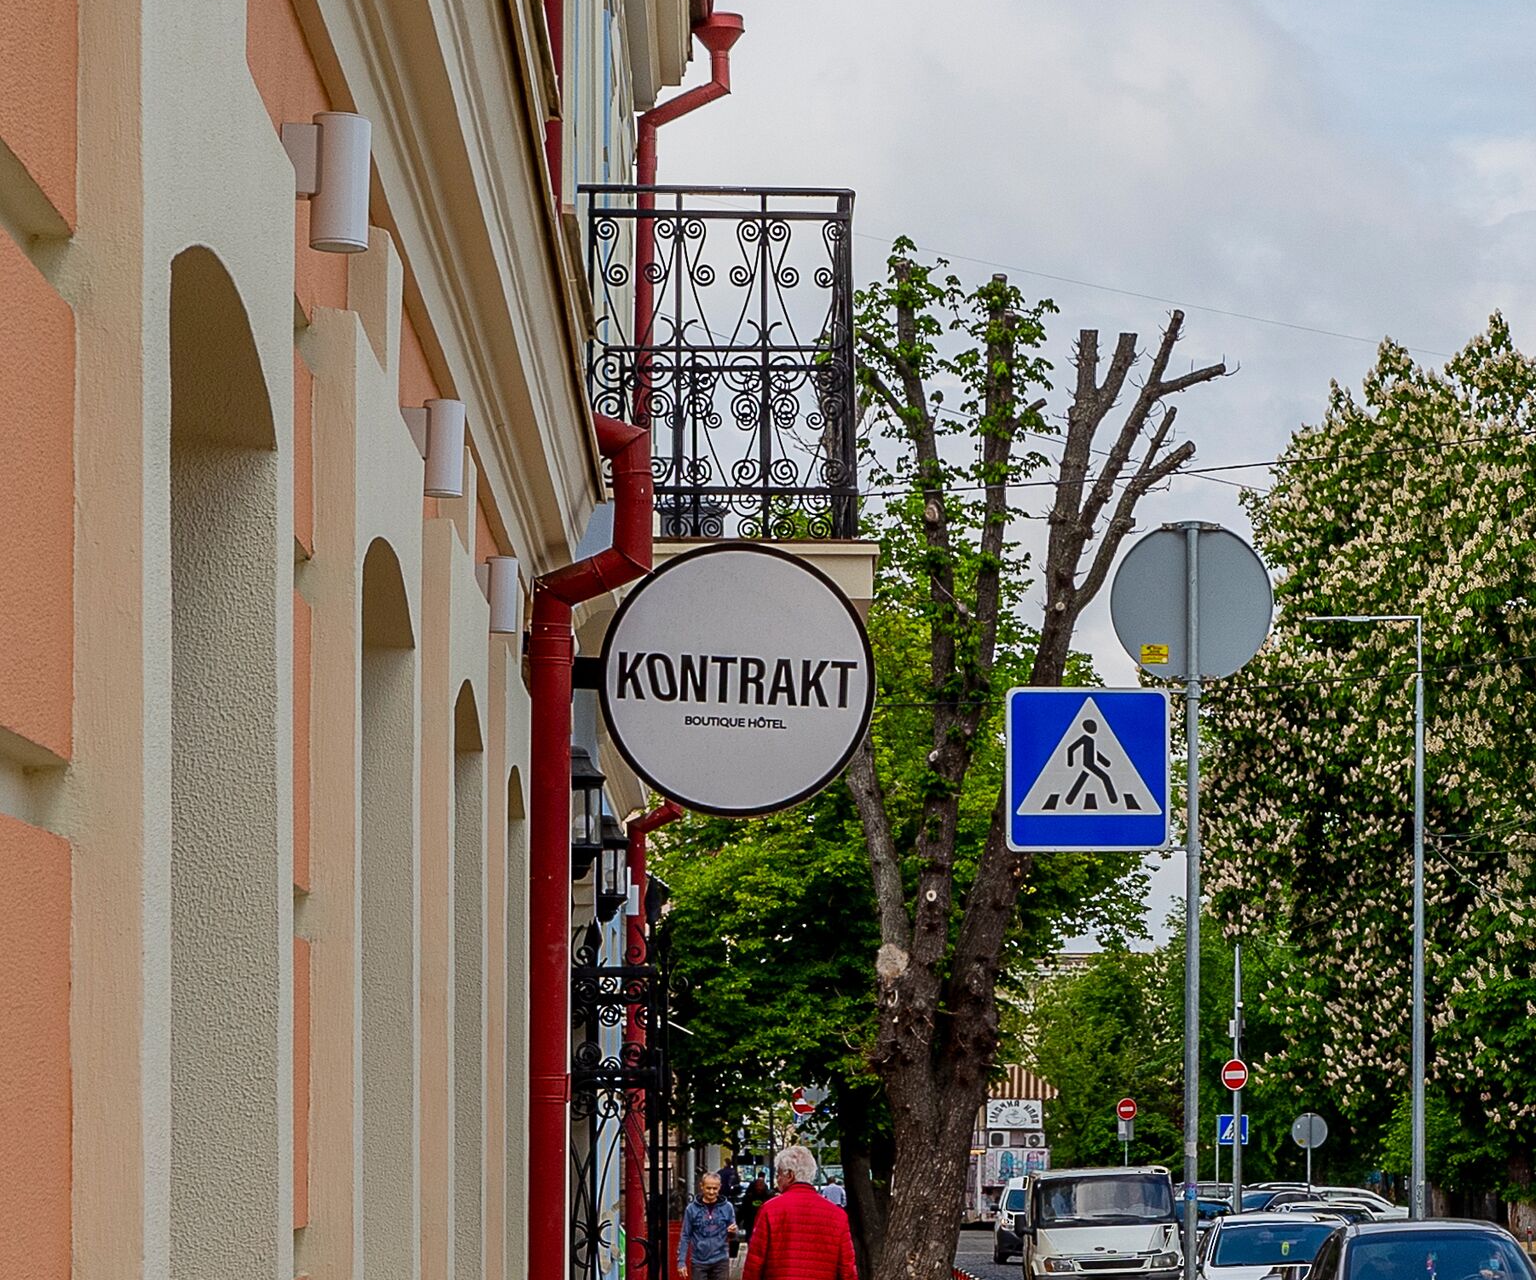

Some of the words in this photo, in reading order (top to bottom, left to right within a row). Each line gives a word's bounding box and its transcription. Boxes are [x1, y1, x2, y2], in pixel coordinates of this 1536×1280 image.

[616, 651, 858, 709] KONTRAKT
[684, 715, 746, 728] BOUTIQUE
[748, 716, 787, 729] HÔTEL
